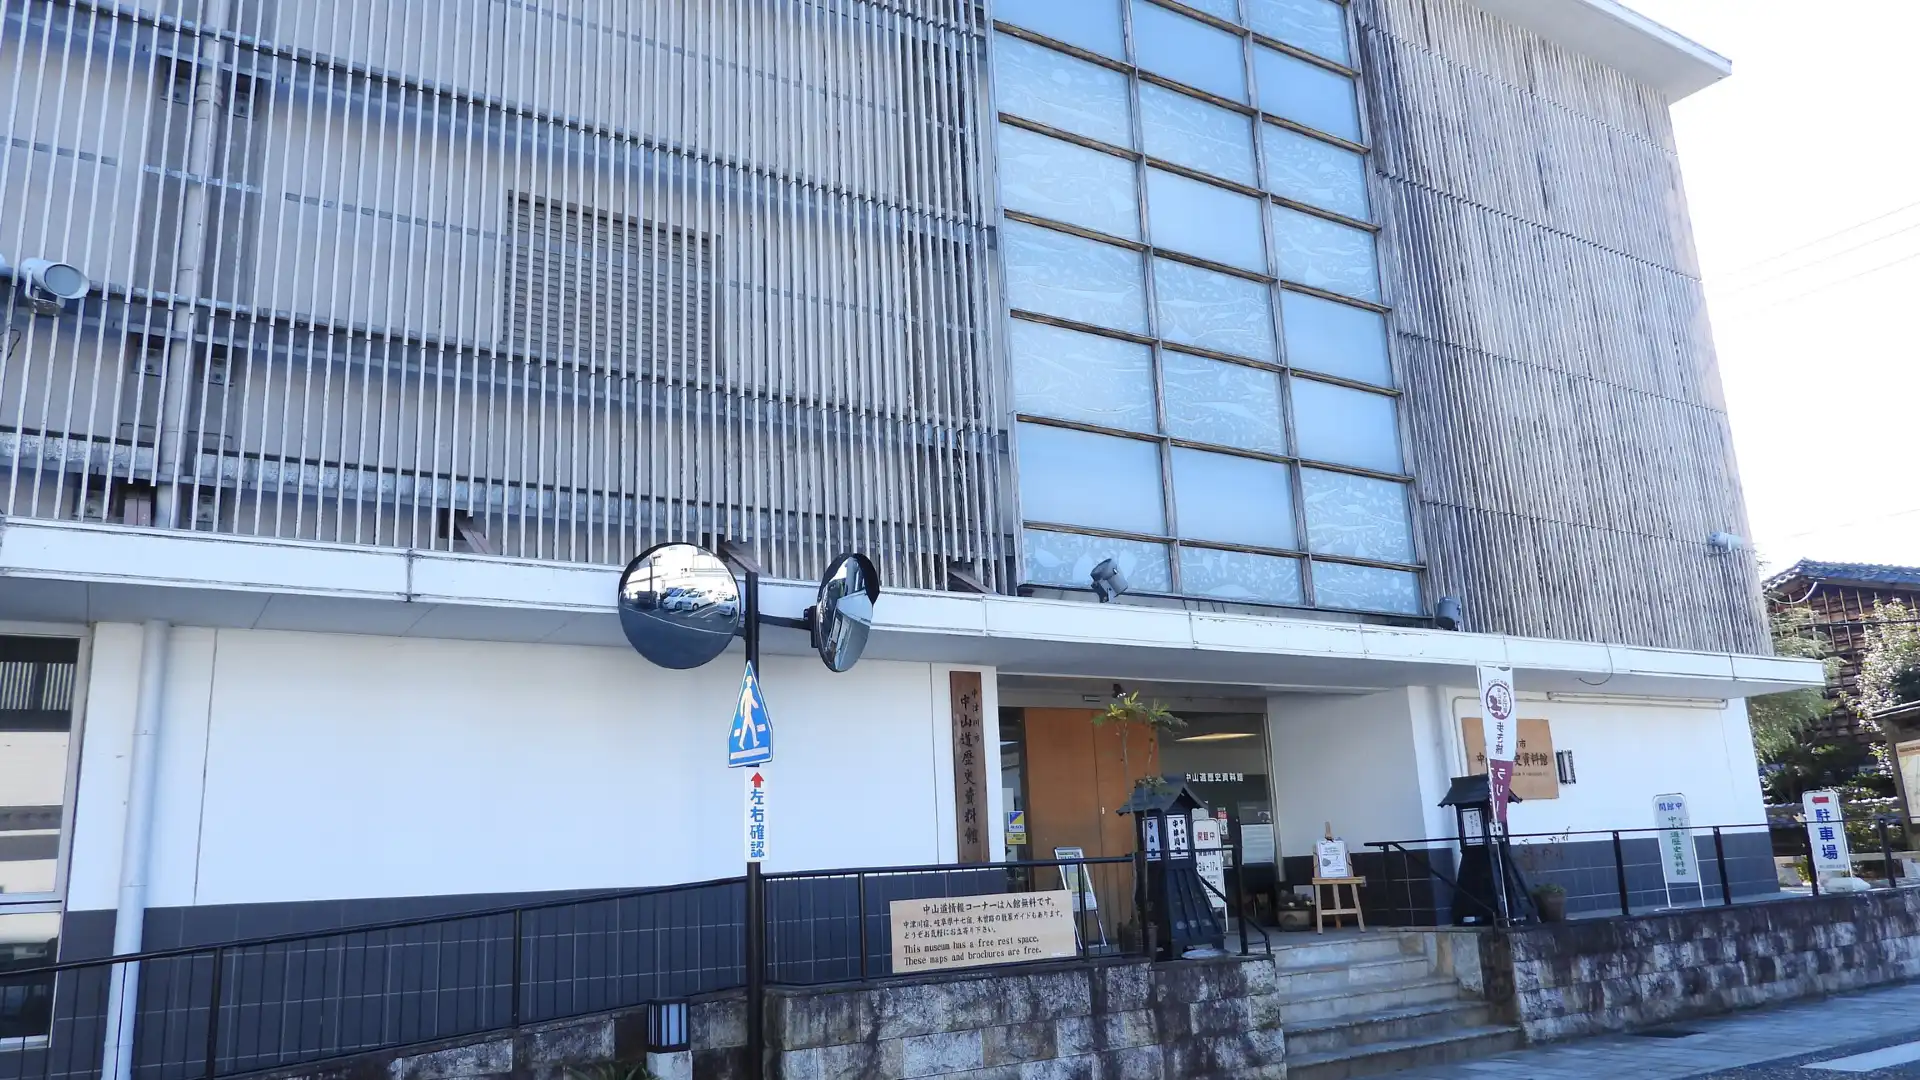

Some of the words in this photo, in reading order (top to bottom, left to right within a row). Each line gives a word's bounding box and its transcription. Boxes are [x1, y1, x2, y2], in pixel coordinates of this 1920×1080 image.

[971, 687, 980, 743] 中津川市
[960, 694, 979, 845] 中山道歴史資料館
[1476, 752, 1549, 768] 中史資料館
[1185, 772, 1244, 782] 中山道歴史資料館
[750, 788, 765, 858] 左右確認
[1815, 808, 1838, 860] 駐車場
[922, 897, 1055, 915] 中山道情報コーナーは入館無料です。
[904, 944, 921, 954] This
[924, 943, 950, 952] museum
[953, 941, 966, 950] has
[978, 939, 994, 948] free
[997, 937, 1014, 946] rest
[1017, 936, 1040, 947] space.
[904, 956, 927, 966] These
[929, 955, 948, 966] maps
[951, 952, 965, 961] and
[968, 949, 1005, 960] brochures
[1007, 948, 1020, 956] are
[1023, 946, 1042, 955] free.
